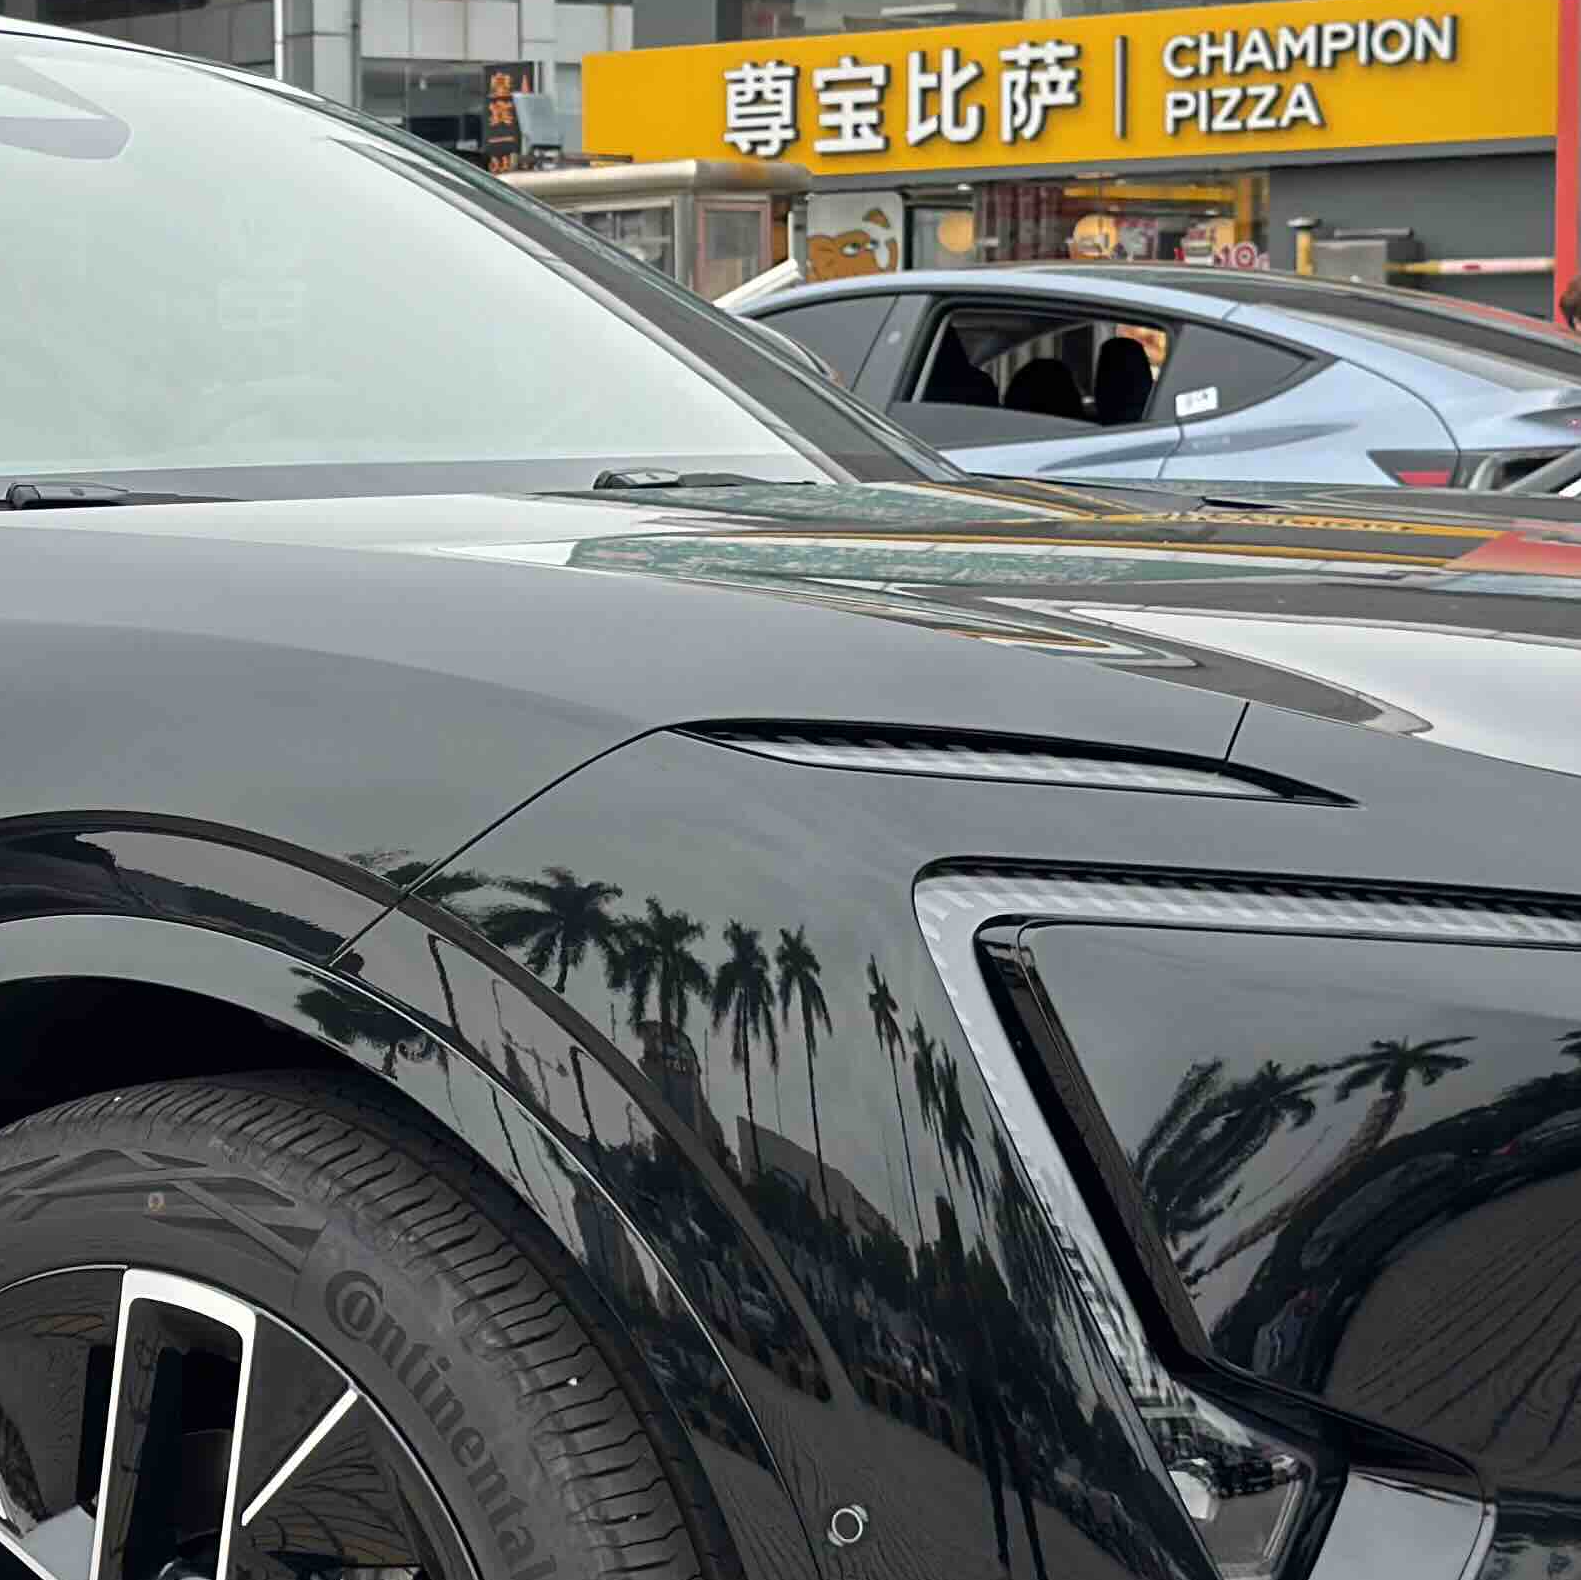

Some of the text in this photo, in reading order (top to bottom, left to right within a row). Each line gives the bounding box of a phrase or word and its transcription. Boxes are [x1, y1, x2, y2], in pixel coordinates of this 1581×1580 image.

[1161, 13, 1458, 79] CHAMPION
[722, 38, 1083, 159] 尊宝比萨
[1164, 80, 1324, 135] PIZZA
